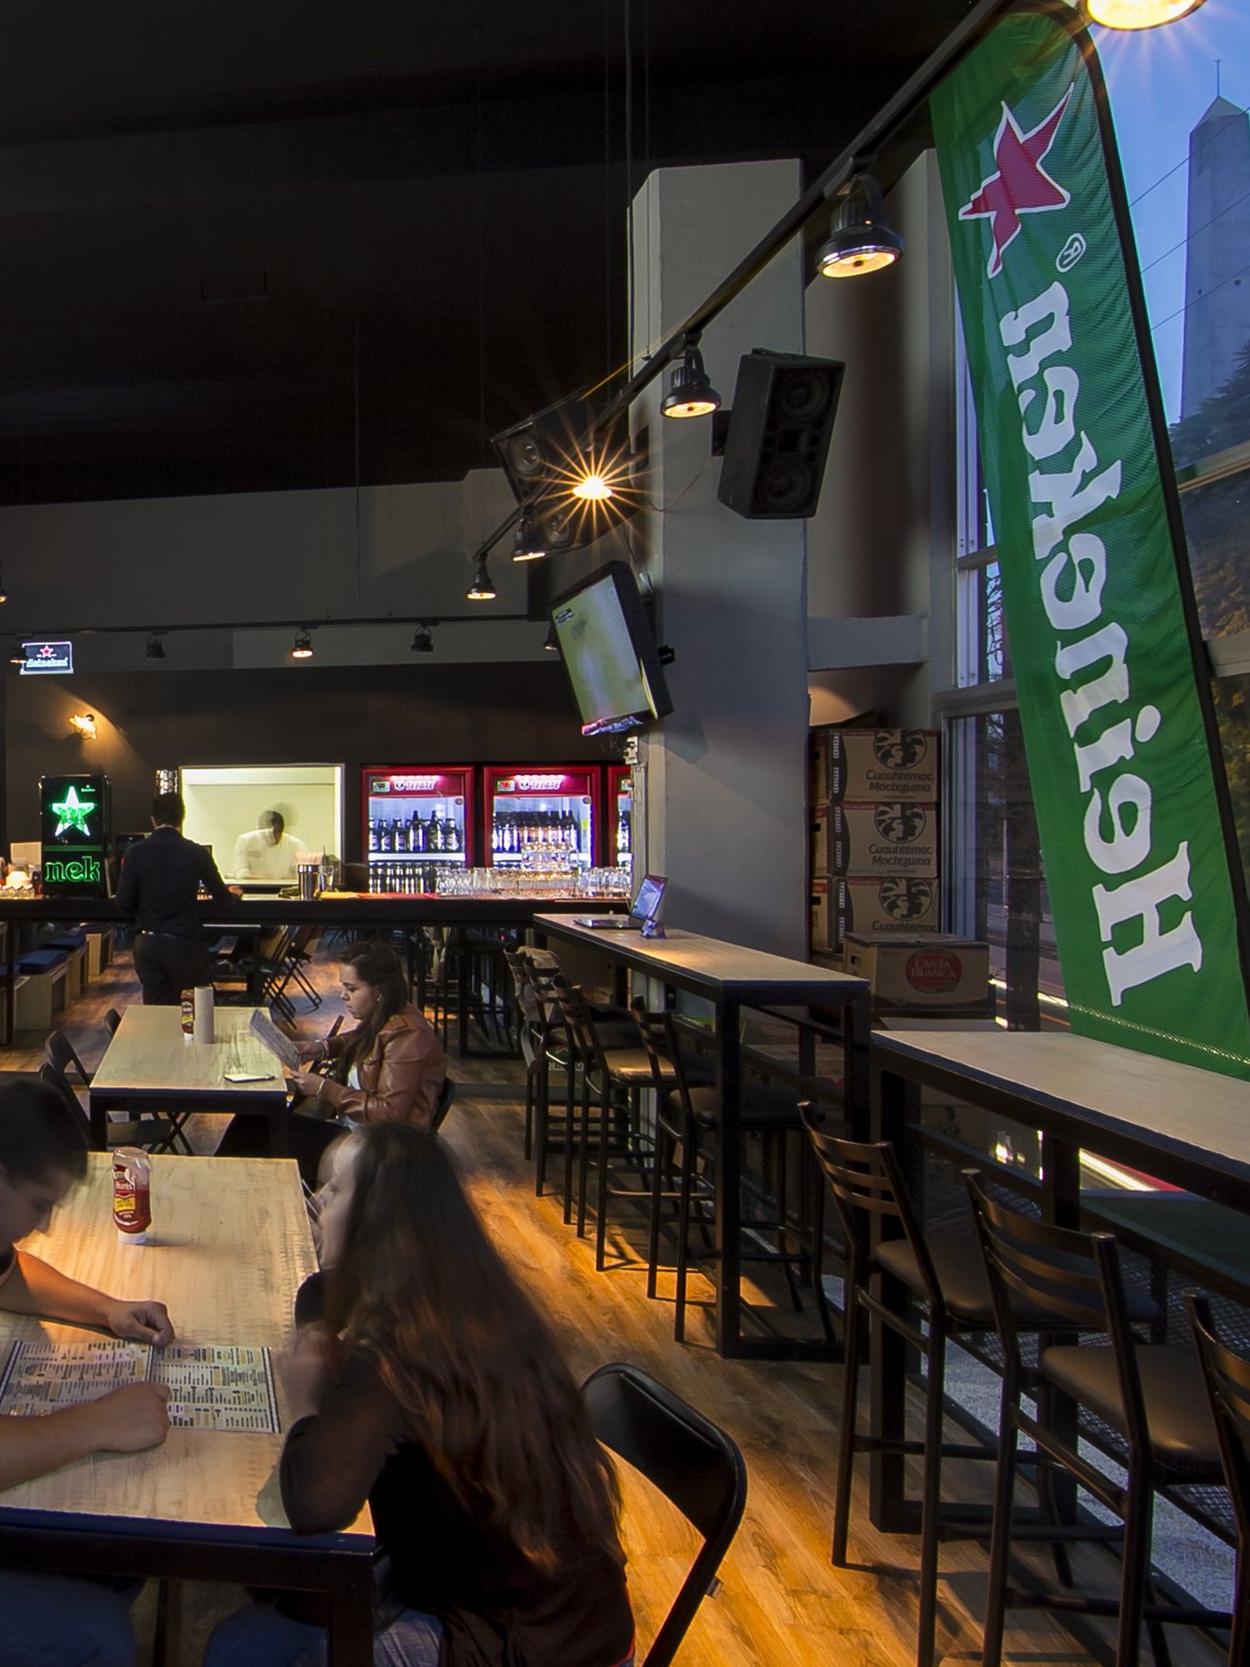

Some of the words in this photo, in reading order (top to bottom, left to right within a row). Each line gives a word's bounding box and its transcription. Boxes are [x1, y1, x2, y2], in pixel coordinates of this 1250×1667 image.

[999, 281, 1203, 1007] Heineken
[865, 769, 934, 781] Cuauhtémoc
[868, 781, 931, 794] Moctezuma
[868, 843, 934, 855] Cuauhtémoc
[871, 855, 931, 868] Moctezuma
[45, 856, 101, 882] nek
[872, 920, 937, 932] Cuauhtémoc
[914, 958, 951, 969] CARTA
[911, 967, 957, 978] BLANCA
